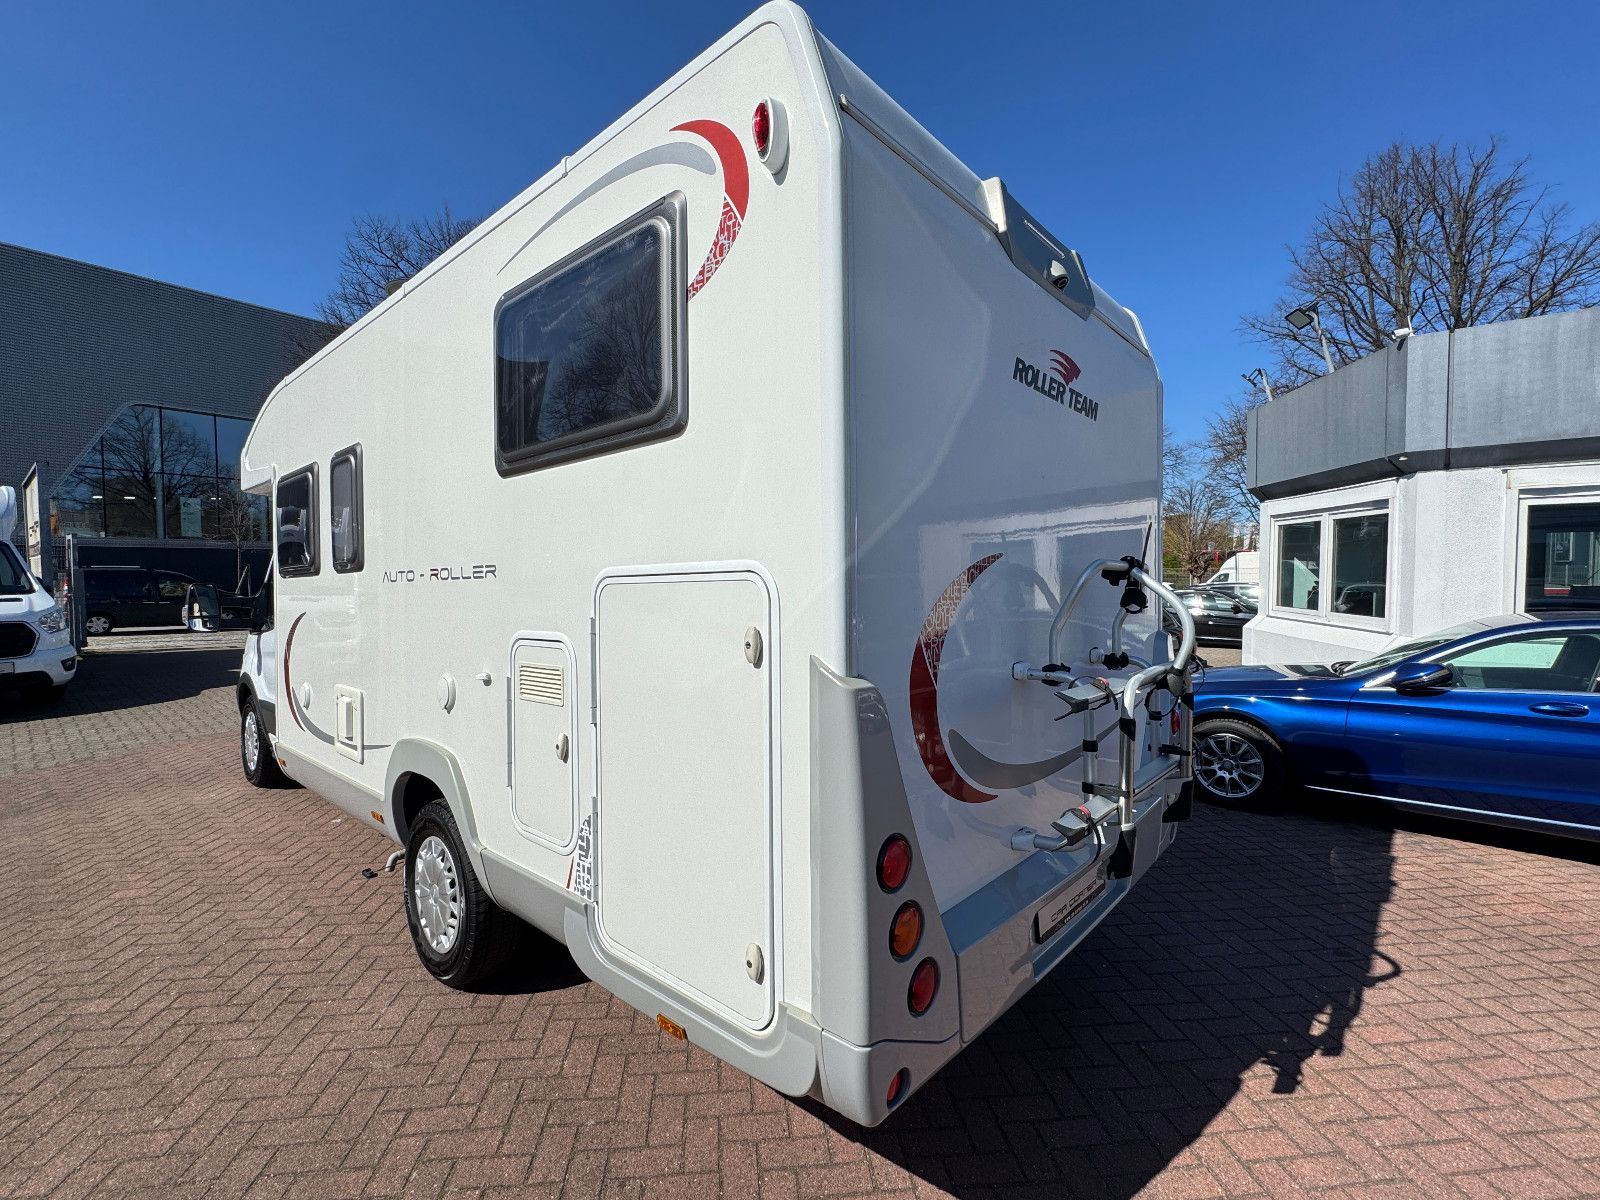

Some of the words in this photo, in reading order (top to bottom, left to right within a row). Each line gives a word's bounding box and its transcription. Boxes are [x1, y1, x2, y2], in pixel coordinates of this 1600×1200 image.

[1012, 356, 1066, 404] ROLLER
[1068, 387, 1099, 422] TEAM
[382, 569, 415, 583] AUTO
[429, 564, 497, 581] ROLLER
